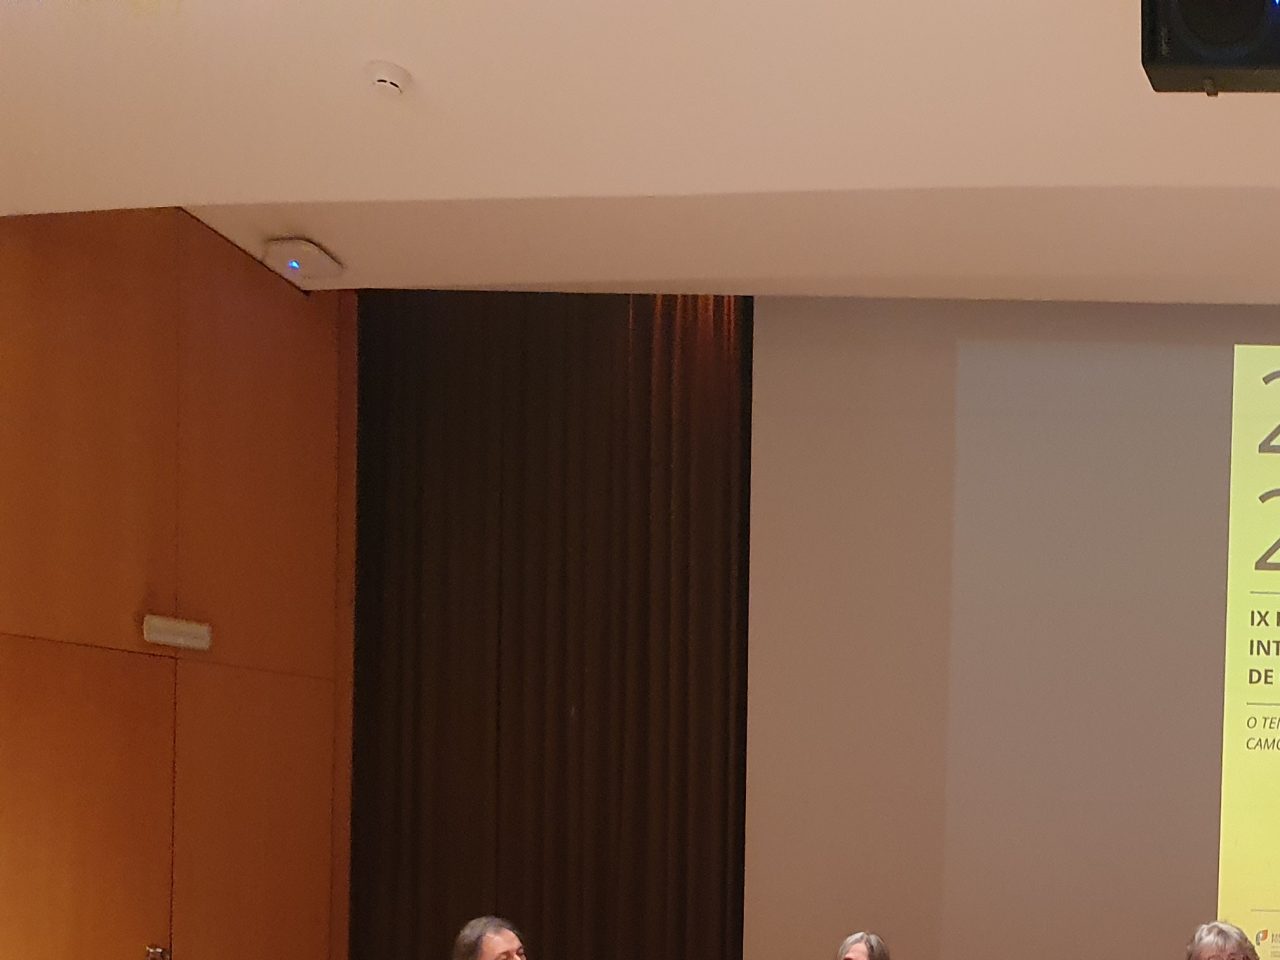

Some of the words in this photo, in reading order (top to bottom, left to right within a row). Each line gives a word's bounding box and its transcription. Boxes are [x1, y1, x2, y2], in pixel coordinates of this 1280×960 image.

[1250, 610, 1269, 627] IX
[1248, 668, 1274, 685] DE
[1246, 716, 1258, 729] O
